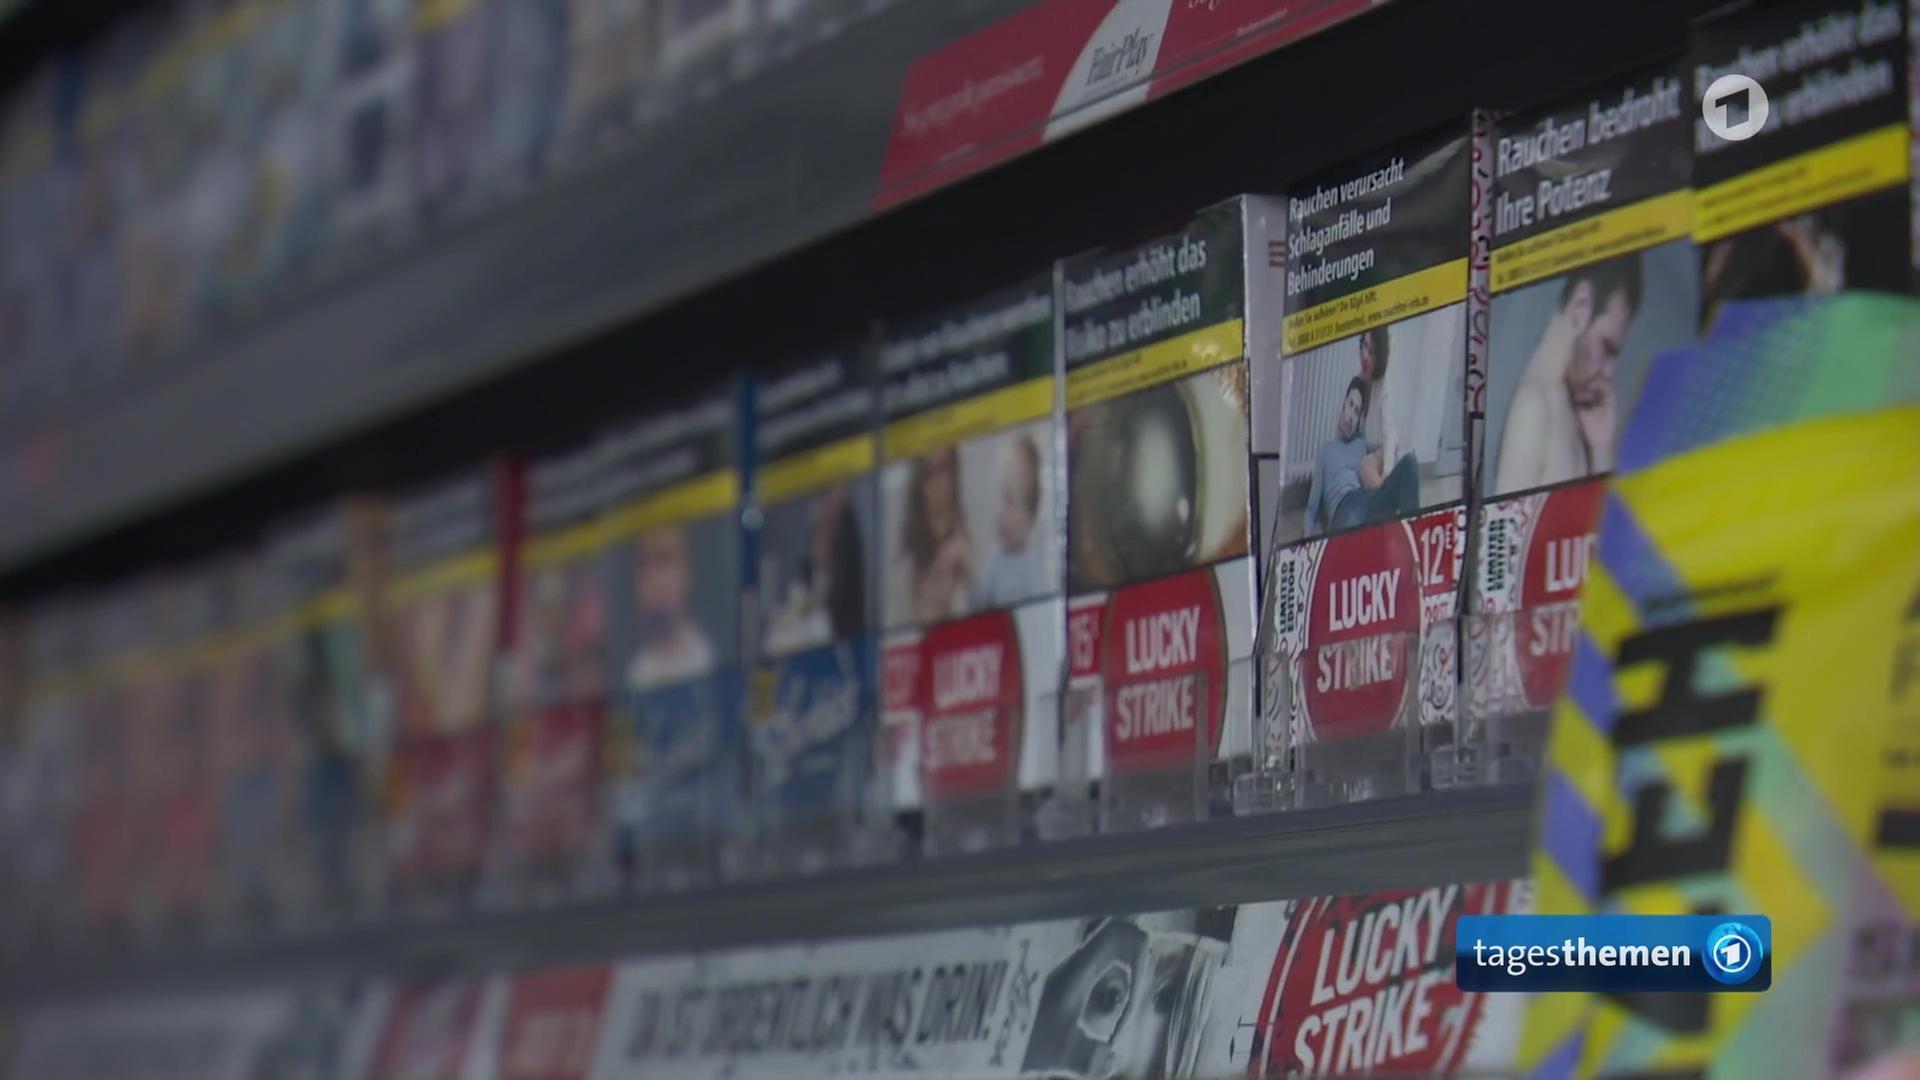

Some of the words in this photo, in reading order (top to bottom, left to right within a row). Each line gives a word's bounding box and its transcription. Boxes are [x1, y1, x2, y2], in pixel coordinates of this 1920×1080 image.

[1497, 117, 1586, 177] Rauchen
[1587, 76, 1681, 145] bedroht
[1289, 185, 1339, 222] Rauchen
[1340, 157, 1404, 203] verursacht
[1496, 191, 1535, 236] Ihre
[1537, 168, 1612, 220] Potenz
[1288, 209, 1364, 260] Schlaganfälle
[1366, 197, 1391, 231] und
[1124, 245, 1175, 292] erhöht
[1176, 236, 1207, 273] das
[1287, 248, 1375, 296] Behinderungen
[1127, 289, 1201, 340] erblinden
[1279, 562, 1287, 635] LIMITED
[1287, 560, 1295, 633] EDITION
[1329, 567, 1401, 632] LUCKY
[1126, 605, 1201, 675] LUCKY
[1317, 636, 1395, 693] STRIKE
[933, 642, 1004, 710] LUCKY
[1116, 674, 1196, 742] STRIKE
[926, 709, 997, 771] STRIKE
[1310, 884, 1460, 1006] LUCKY
[1291, 966, 1454, 1080] STRIKE
